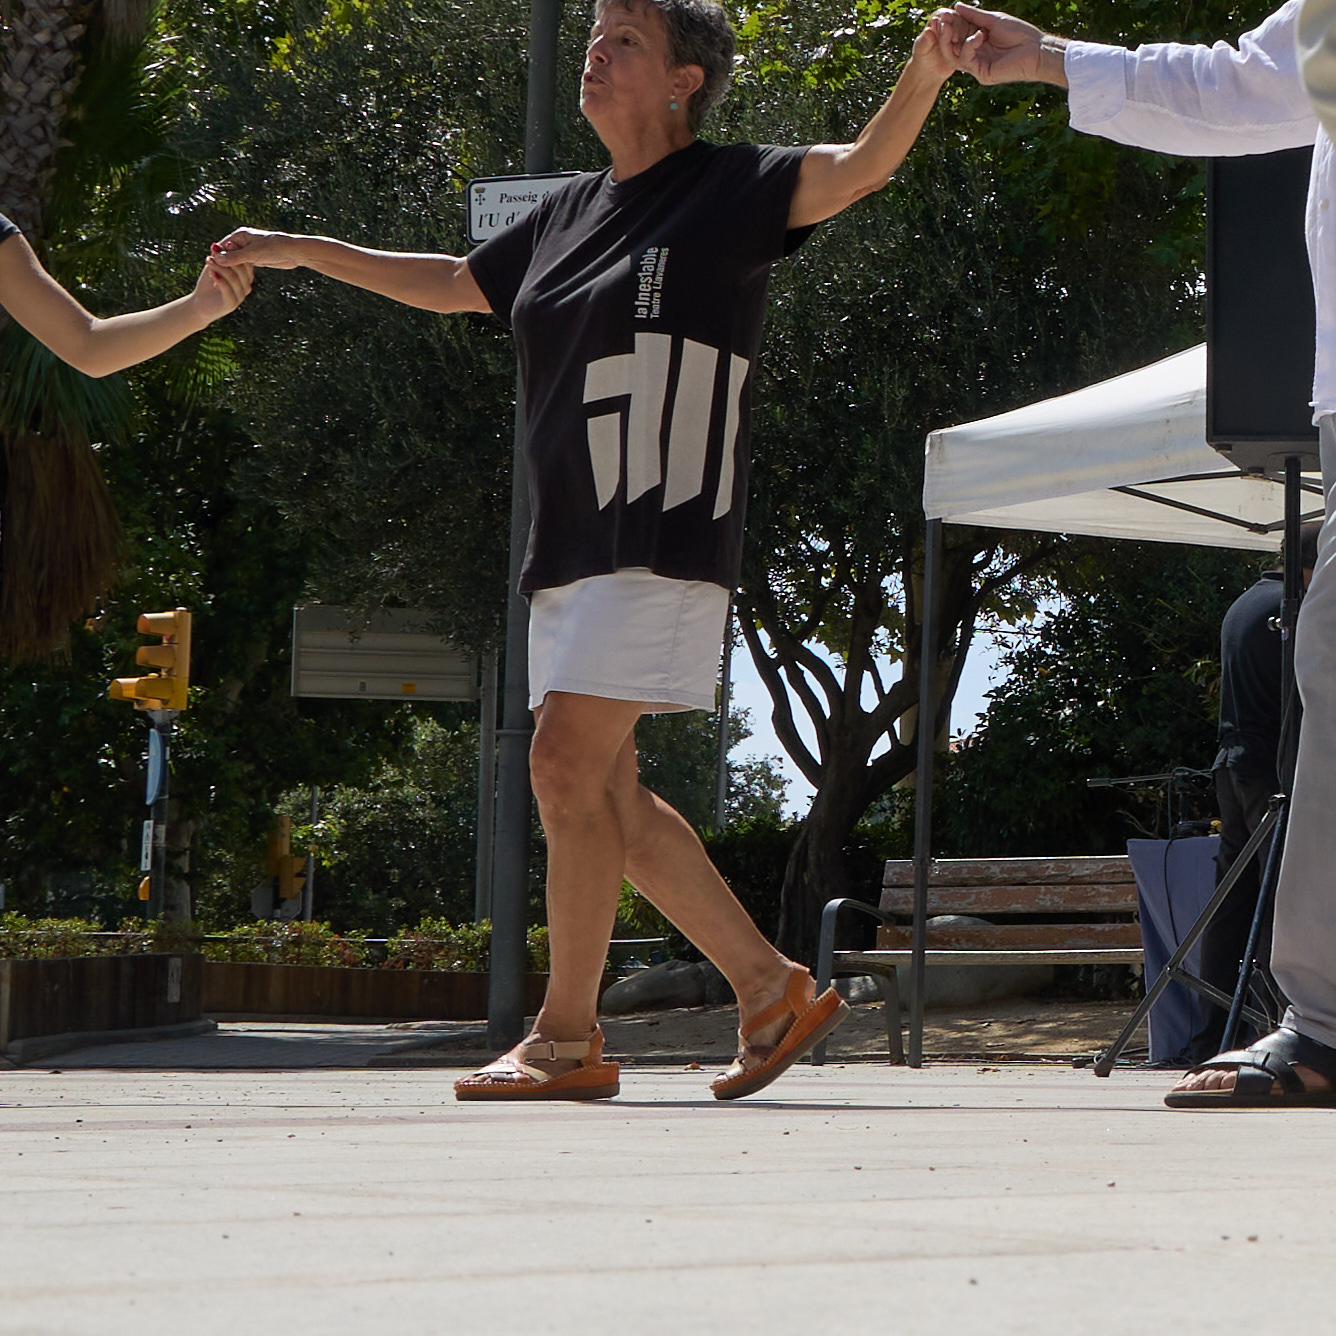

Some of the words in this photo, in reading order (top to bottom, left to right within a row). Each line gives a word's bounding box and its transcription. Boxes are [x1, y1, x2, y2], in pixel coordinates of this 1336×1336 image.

[499, 191, 538, 204] Passeig
[634, 246, 659, 306] Inestable
[652, 247, 670, 290] Llavaneres
[634, 307, 648, 319] la
[649, 292, 662, 319] Teatre
